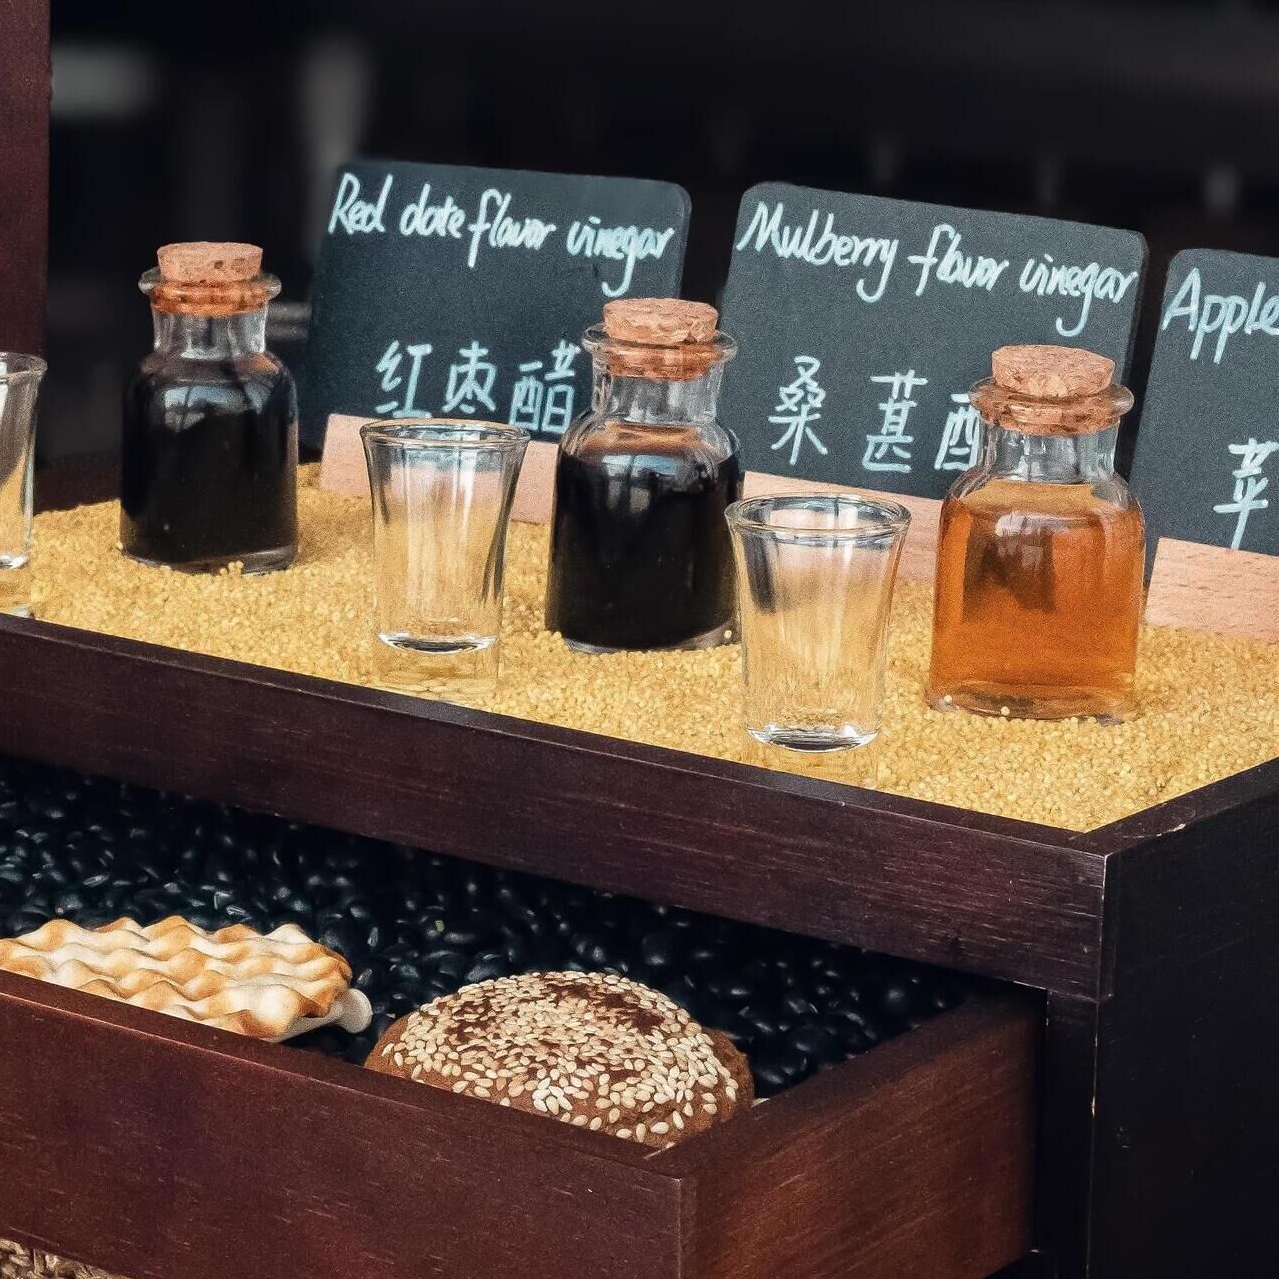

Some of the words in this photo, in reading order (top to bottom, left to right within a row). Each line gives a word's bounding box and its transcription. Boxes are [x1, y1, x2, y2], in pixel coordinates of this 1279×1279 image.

[327, 172, 394, 235] Red
[398, 182, 466, 239] date
[566, 216, 674, 298] vinegar
[735, 200, 899, 304] Mulberry
[907, 223, 1010, 297] flavor
[1018, 253, 1138, 337] vinegar
[1161, 267, 1279, 365] Apple
[374, 339, 582, 435] 红枣醋
[1212, 437, 1279, 551] 苹
